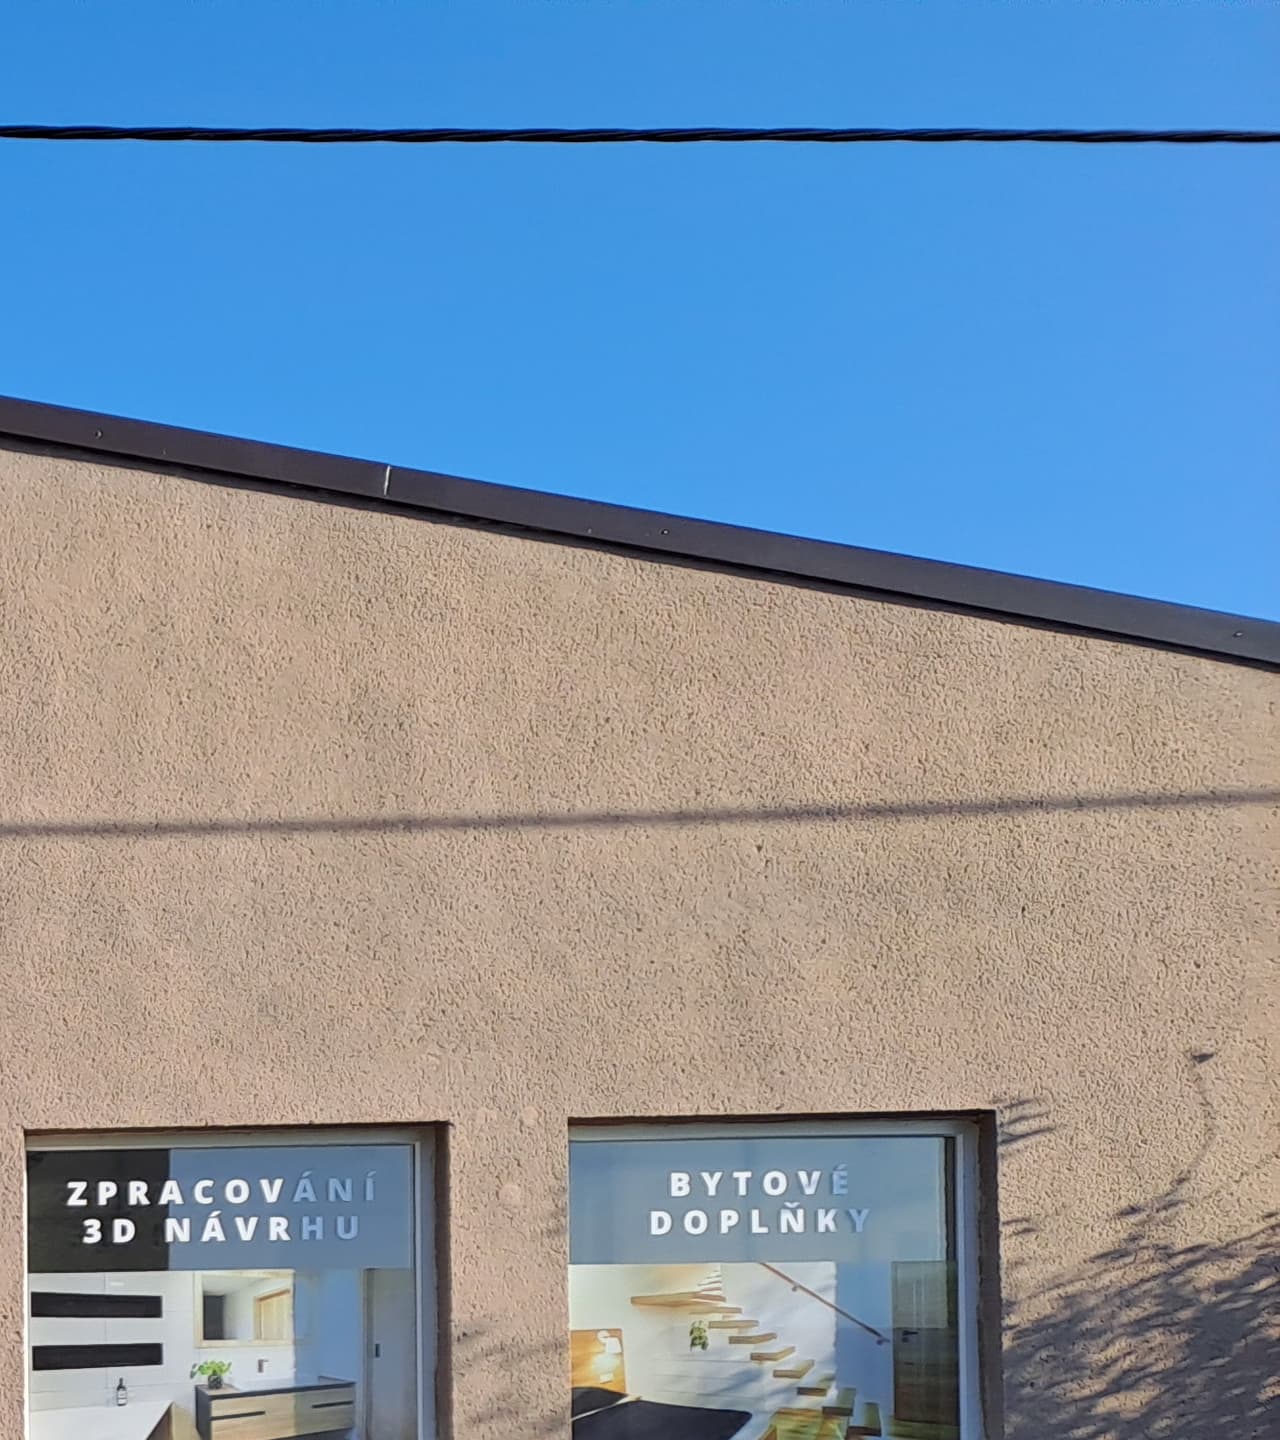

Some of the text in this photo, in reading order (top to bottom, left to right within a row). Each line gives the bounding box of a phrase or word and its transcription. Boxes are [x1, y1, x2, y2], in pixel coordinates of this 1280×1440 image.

[65, 1170, 378, 1207] ZPRACOVÁNÍ
[669, 1163, 850, 1198] BYTOVÉ
[81, 1210, 360, 1245] 3D NÁVRHU
[649, 1202, 872, 1236] DOPLŇKY
